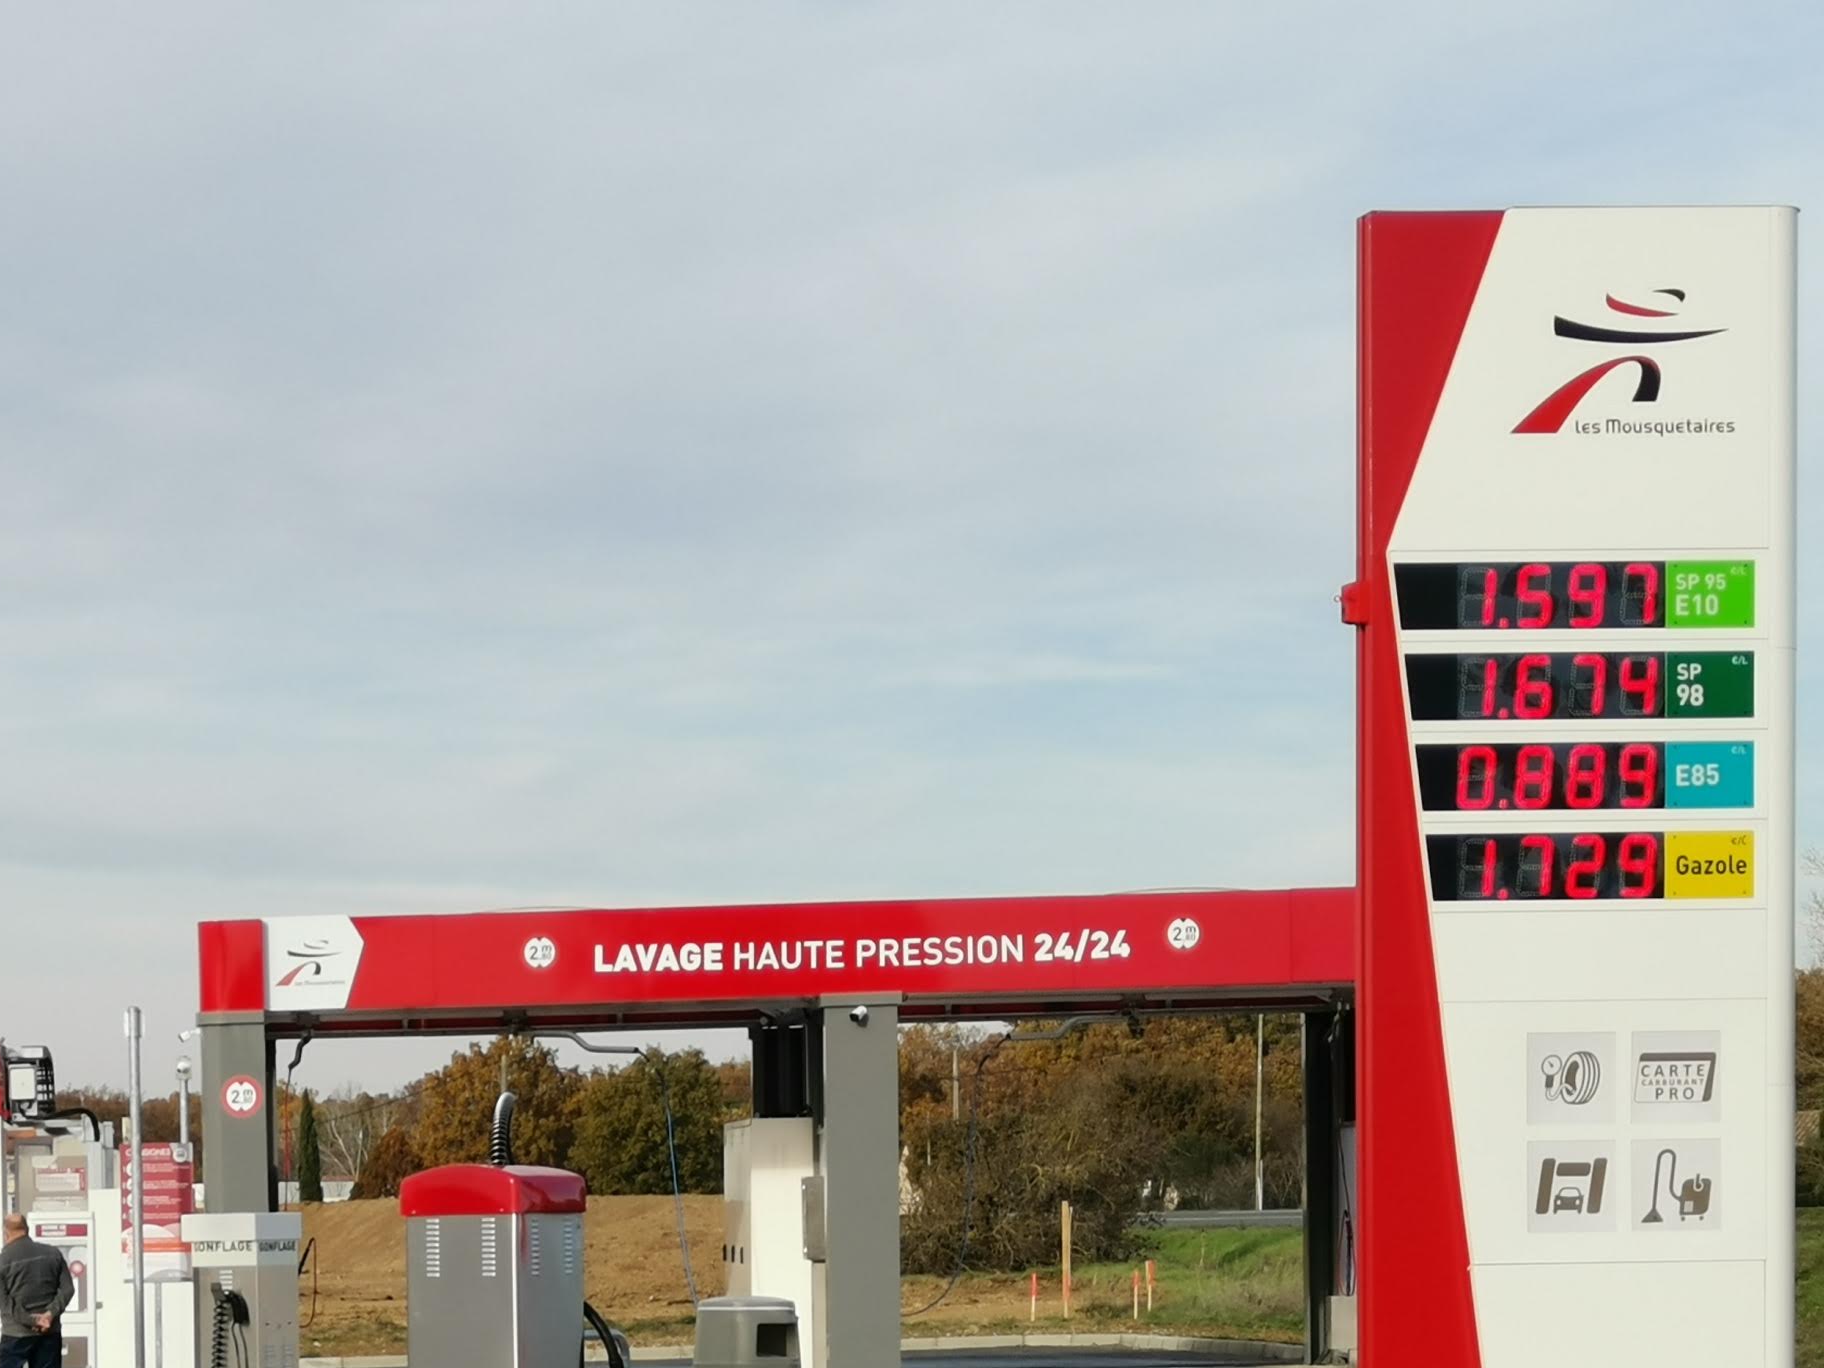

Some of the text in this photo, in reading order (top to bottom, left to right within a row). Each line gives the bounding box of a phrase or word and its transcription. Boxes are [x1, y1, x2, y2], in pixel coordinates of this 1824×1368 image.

[1575, 418, 1736, 437] les Mousquetaires
[1481, 563, 1726, 629] 1.597 SP 95
[1675, 594, 1719, 616] E10
[1480, 653, 1702, 719] 1.674 SP
[1676, 684, 1704, 706] 98
[1455, 743, 1719, 810] 0.889 E85
[1480, 833, 1747, 900] 1.729 Gazole
[594, 929, 1131, 973] LAVAGE HAUTE PRESSION 24/24
[1640, 1063, 1705, 1078] CARTE
[1641, 1078, 1704, 1087] CARBURANT
[1655, 1087, 1695, 1101] PRO
[193, 1240, 253, 1252] GONFLAGE
[258, 1240, 296, 1252] GONFLAGE
